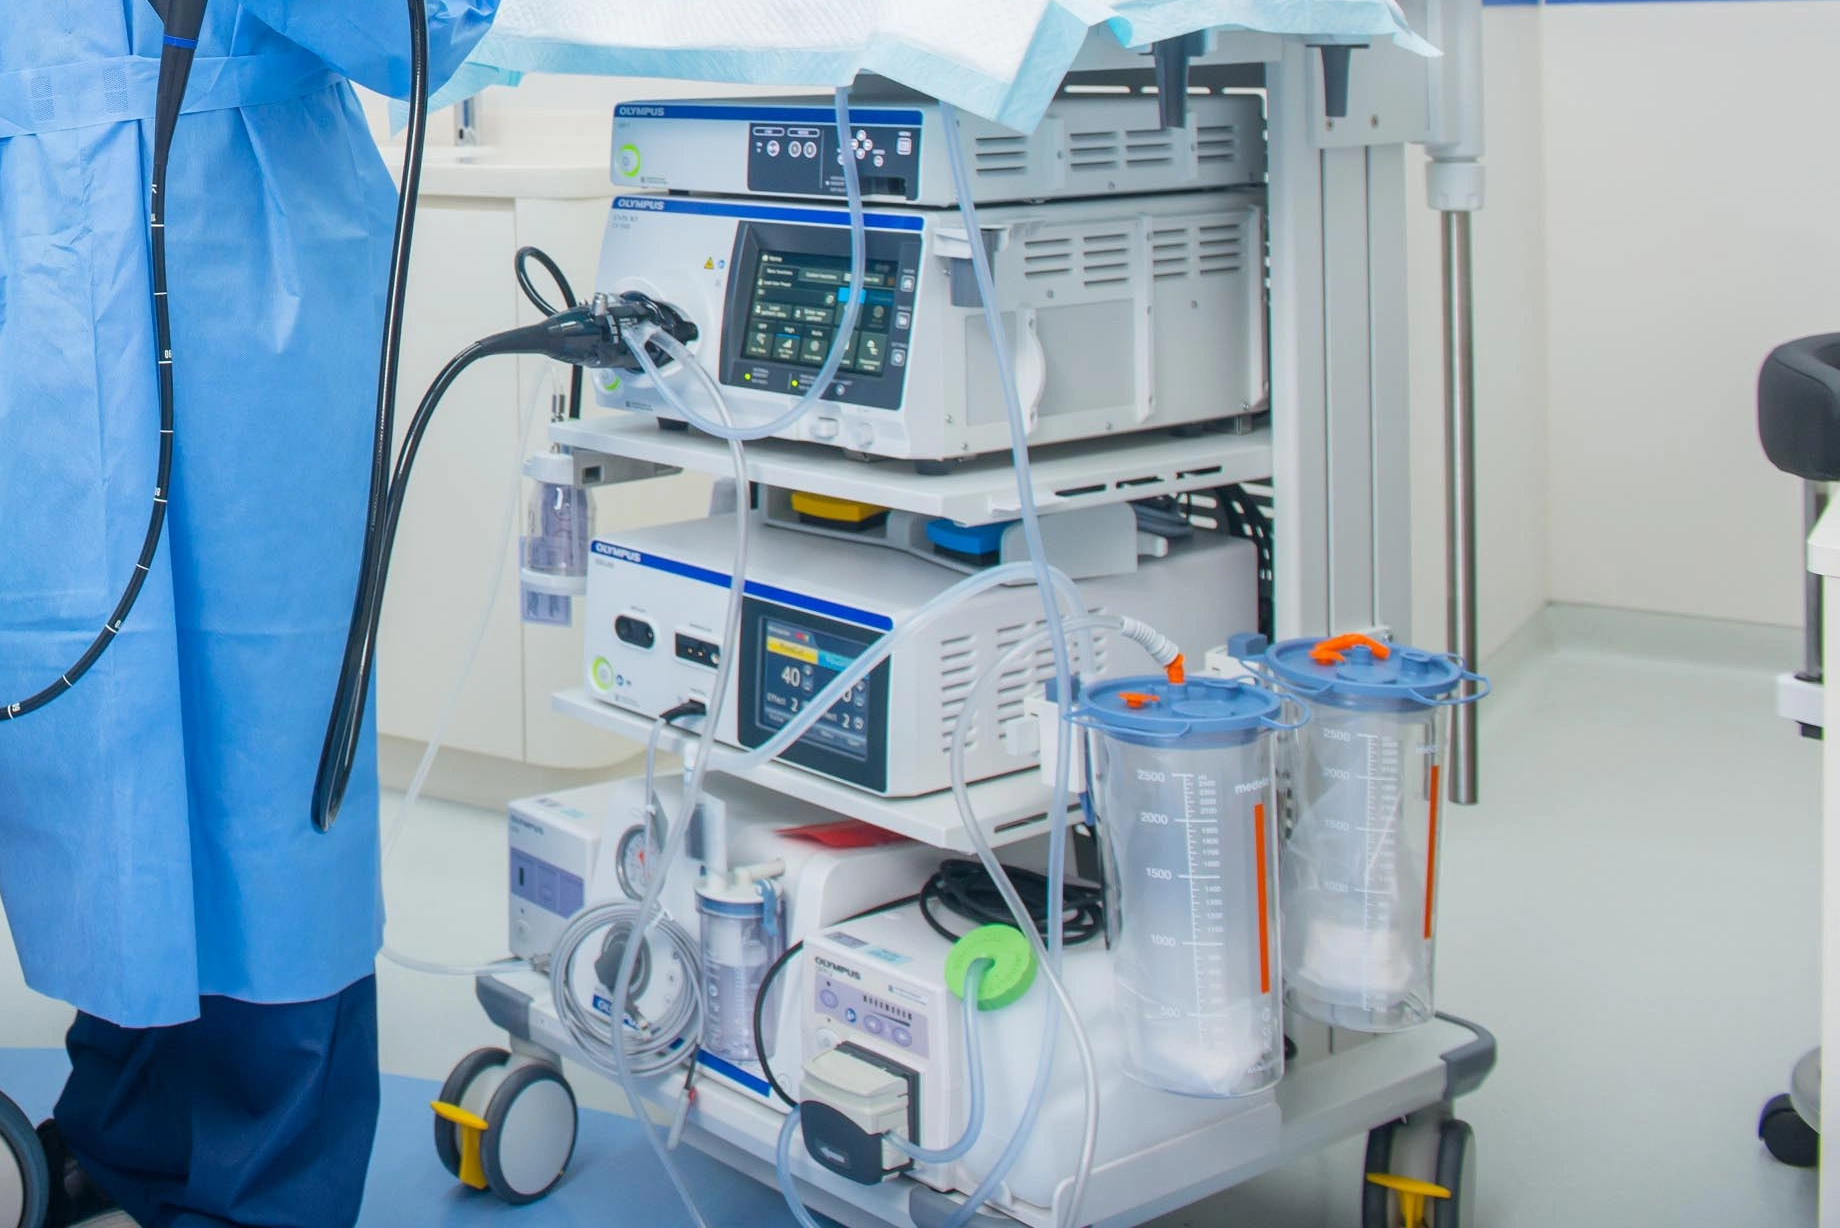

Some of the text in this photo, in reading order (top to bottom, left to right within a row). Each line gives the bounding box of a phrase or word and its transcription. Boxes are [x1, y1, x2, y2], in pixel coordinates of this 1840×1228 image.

[620, 107, 665, 117] OLYMPUS
[618, 199, 664, 210] OLYMPUS
[595, 543, 641, 563] OLYMPUS
[781, 665, 800, 687] 40
[767, 692, 799, 712] Effect 2
[842, 714, 850, 729] 2
[1137, 769, 1165, 783] 2500
[1141, 811, 1168, 825] 2000
[1146, 867, 1172, 880] 1500
[1151, 933, 1176, 947] 1000
[815, 956, 861, 981] OLYMPUS
